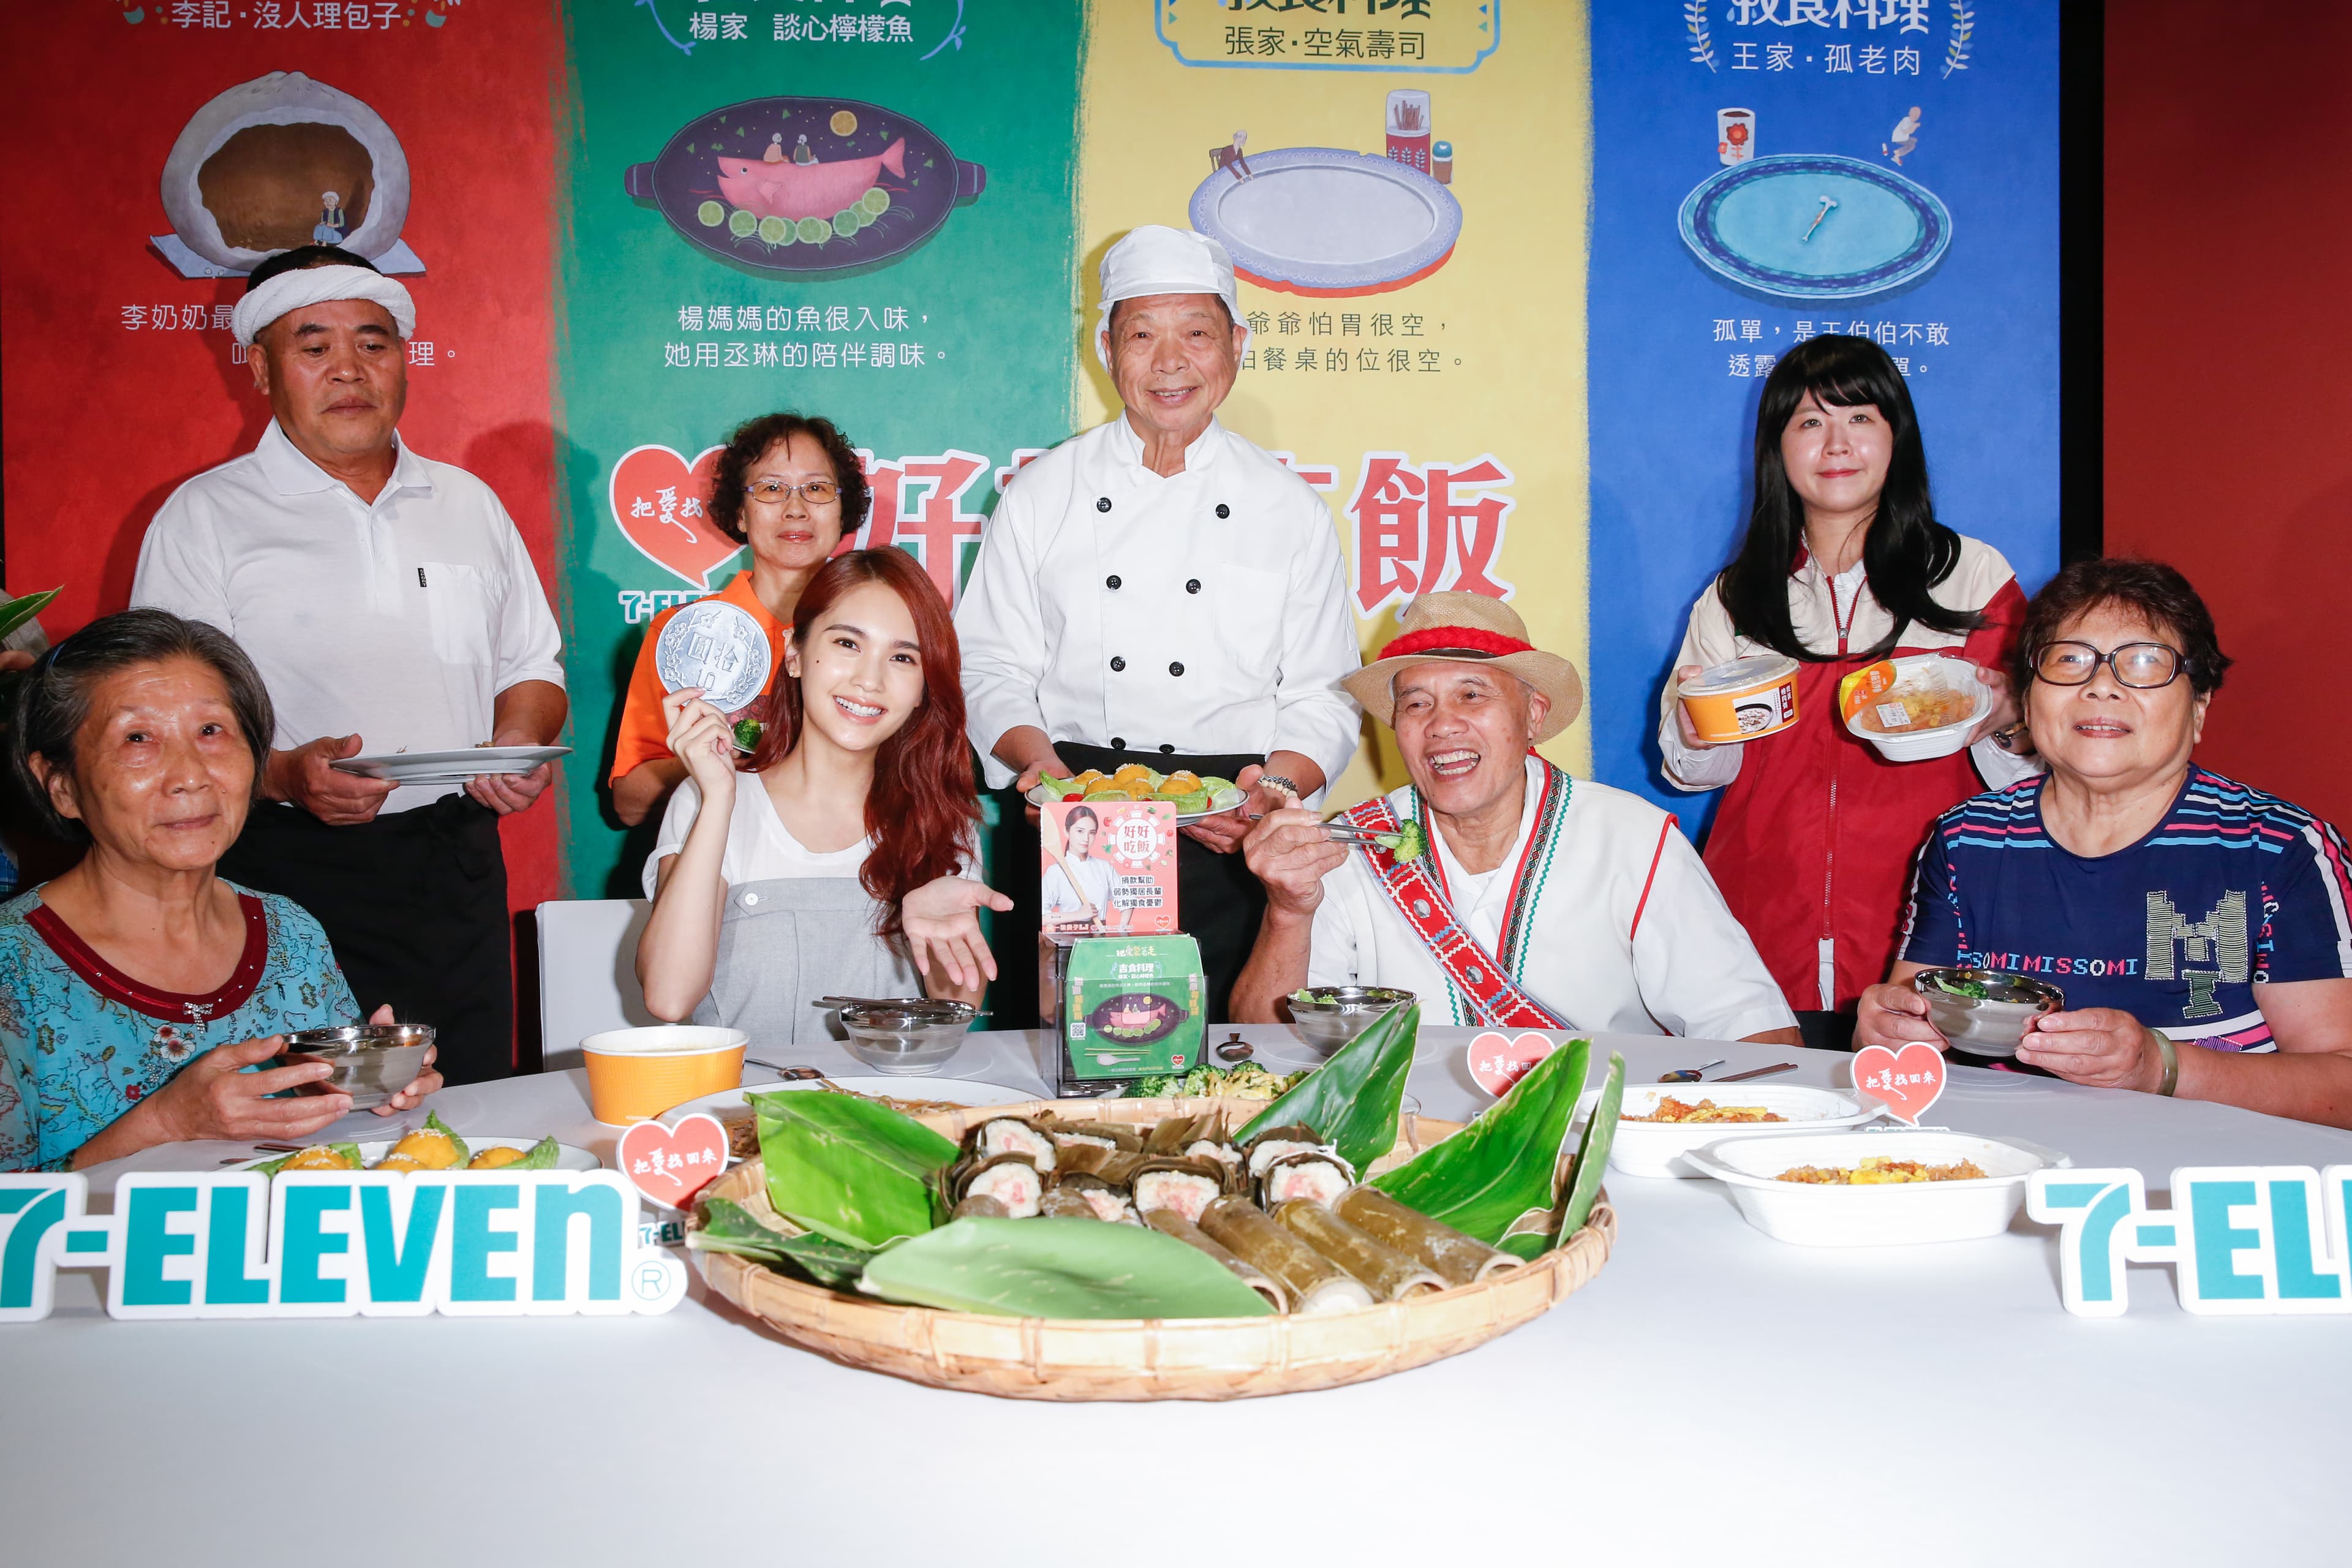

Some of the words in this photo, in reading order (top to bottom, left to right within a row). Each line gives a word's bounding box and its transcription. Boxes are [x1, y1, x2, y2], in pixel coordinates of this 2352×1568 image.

[689, 12, 748, 40] 楊家
[773, 13, 914, 42] 談心檸檬魚
[121, 304, 234, 330] 李奶奶最
[1123, 825, 1150, 839] 好好
[1123, 840, 1150, 853] 吃飯
[1479, 1054, 1541, 1086] 把愛找回
[1866, 1068, 1936, 1101] 把愛找回來
[633, 1147, 717, 1186] 把愛找回來
[639, 1221, 685, 1245] 7-EL
[2044, 1178, 2352, 1302] 7-EL
